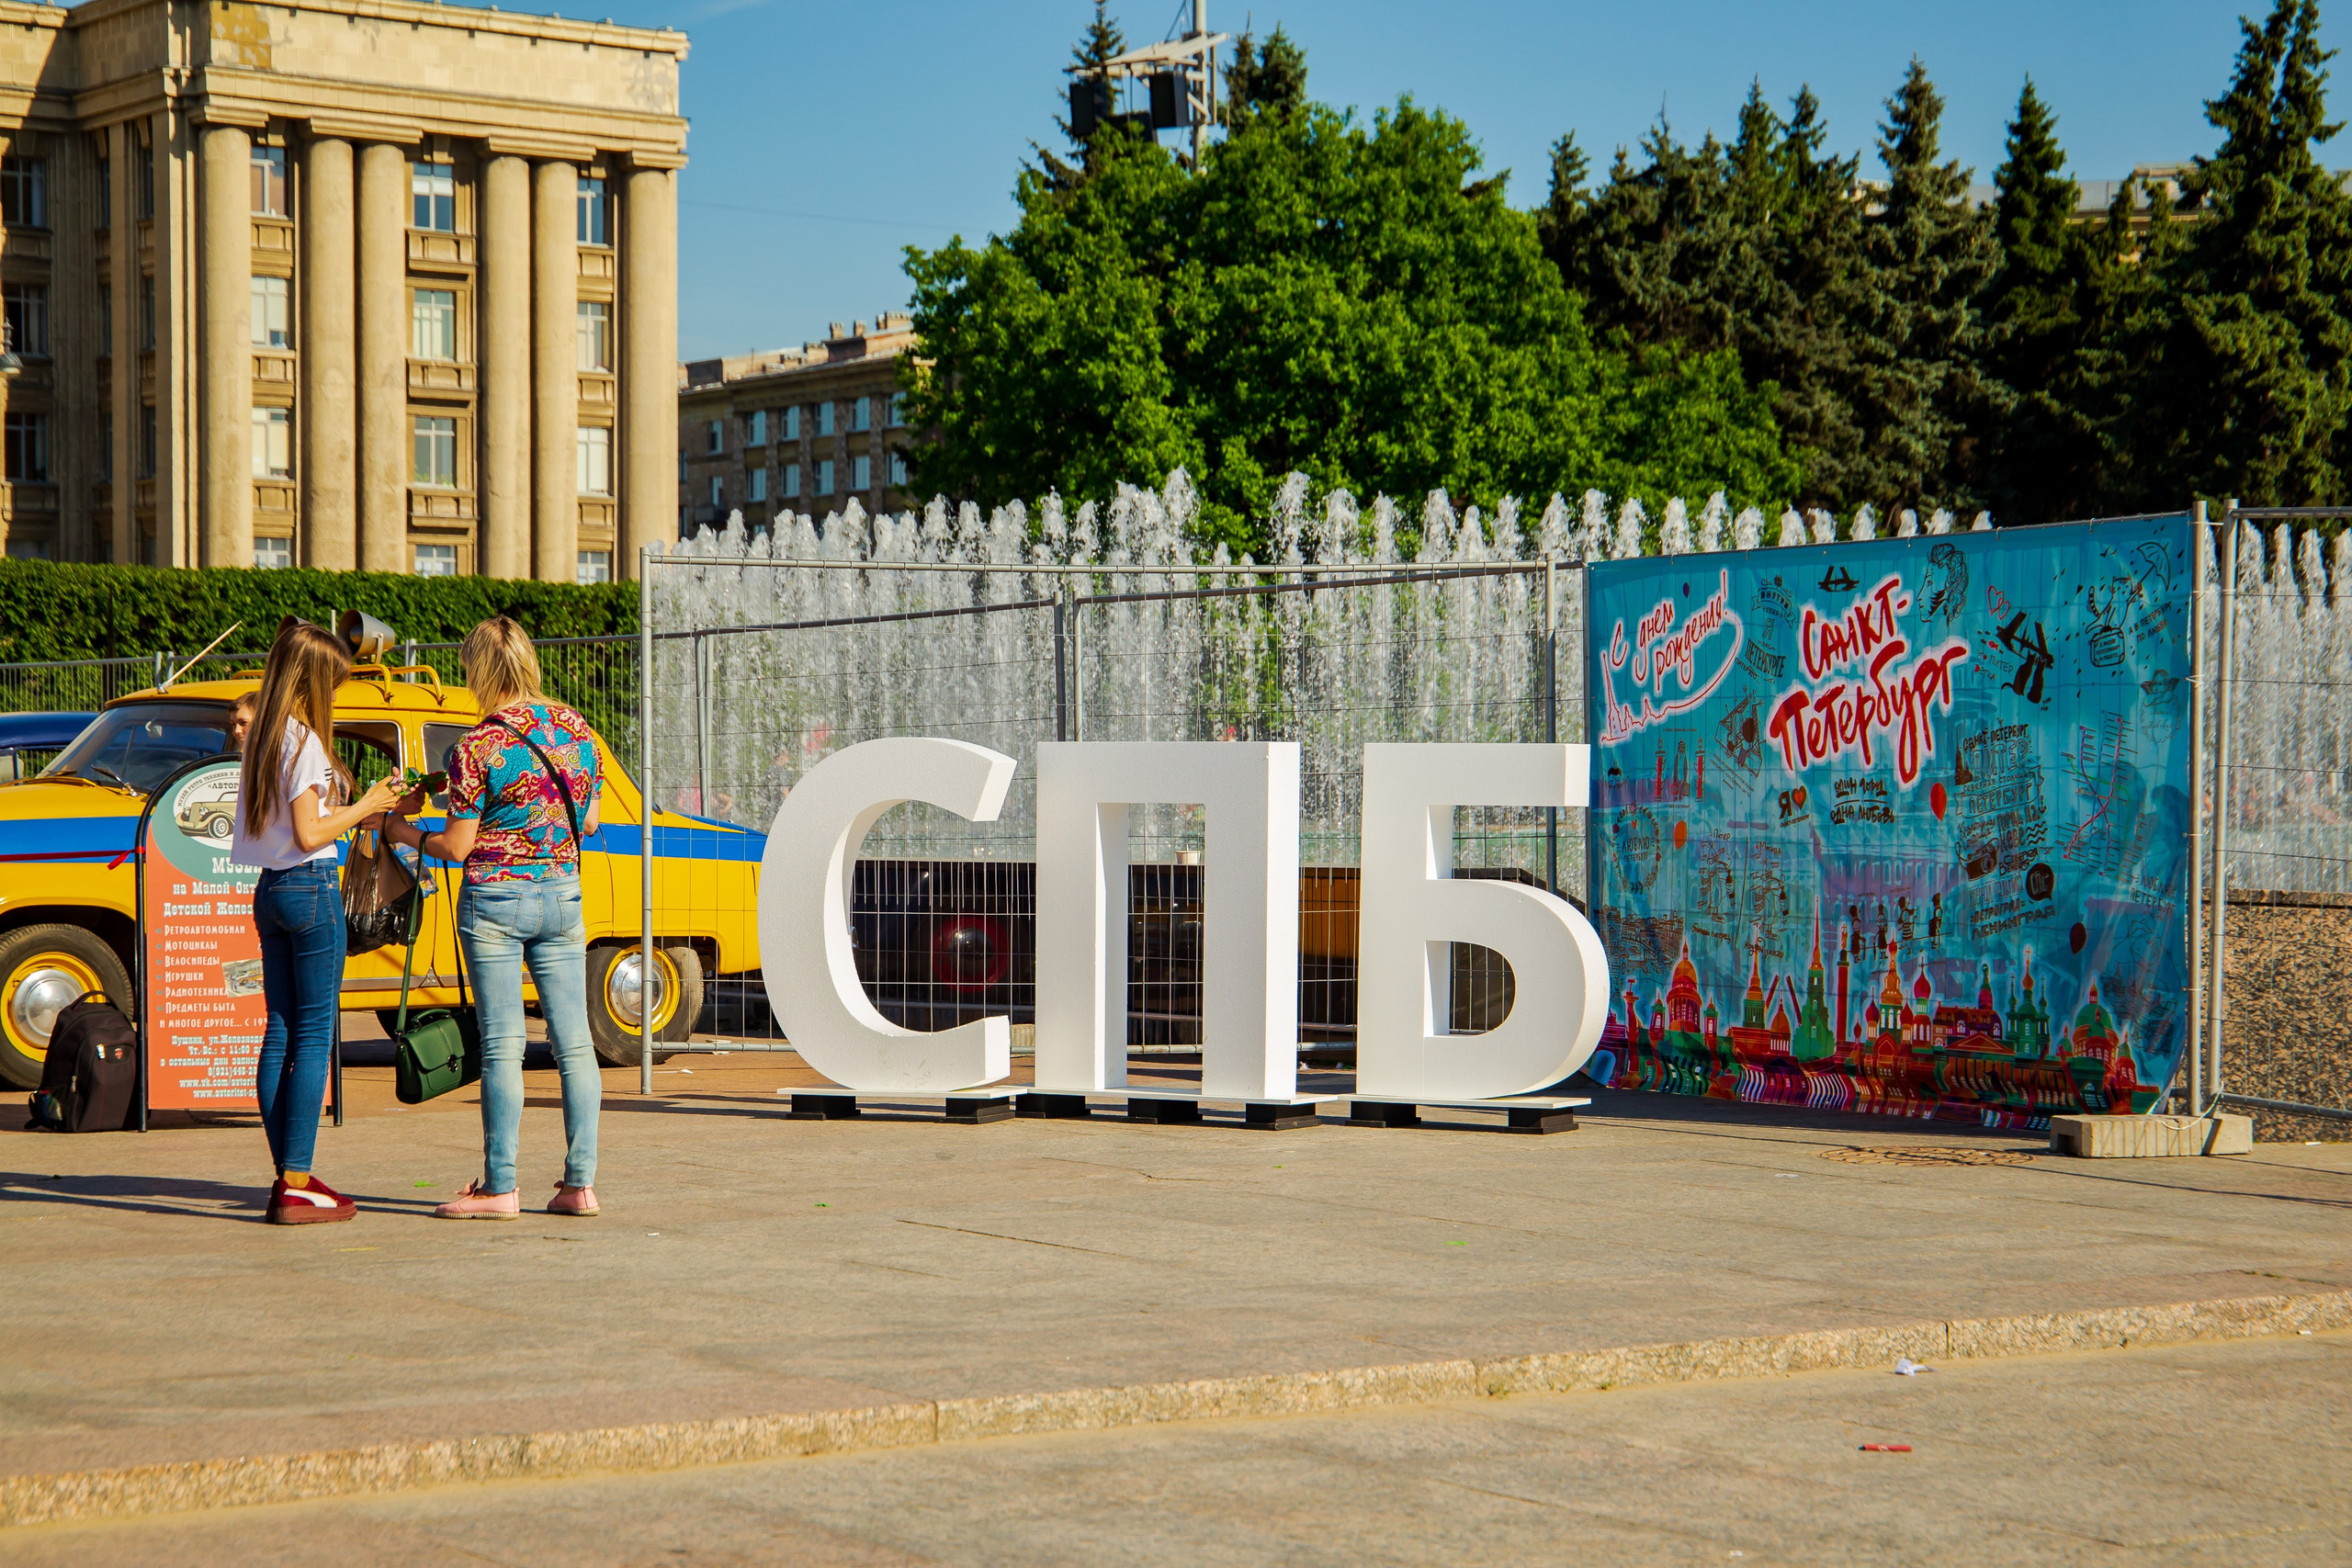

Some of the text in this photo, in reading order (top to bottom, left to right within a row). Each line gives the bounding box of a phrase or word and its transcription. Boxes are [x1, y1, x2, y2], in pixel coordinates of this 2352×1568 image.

[1968, 783, 2033, 814] ПЕТЕРБУРГ
[1622, 836, 1650, 853] ЛЮБЛЮ
[173, 884, 187, 896] на
[192, 881, 231, 895] Малой
[163, 901, 211, 918] Детской
[758, 736, 1611, 1100] СПБ
[229, 1044, 251, 1055] 11:00
